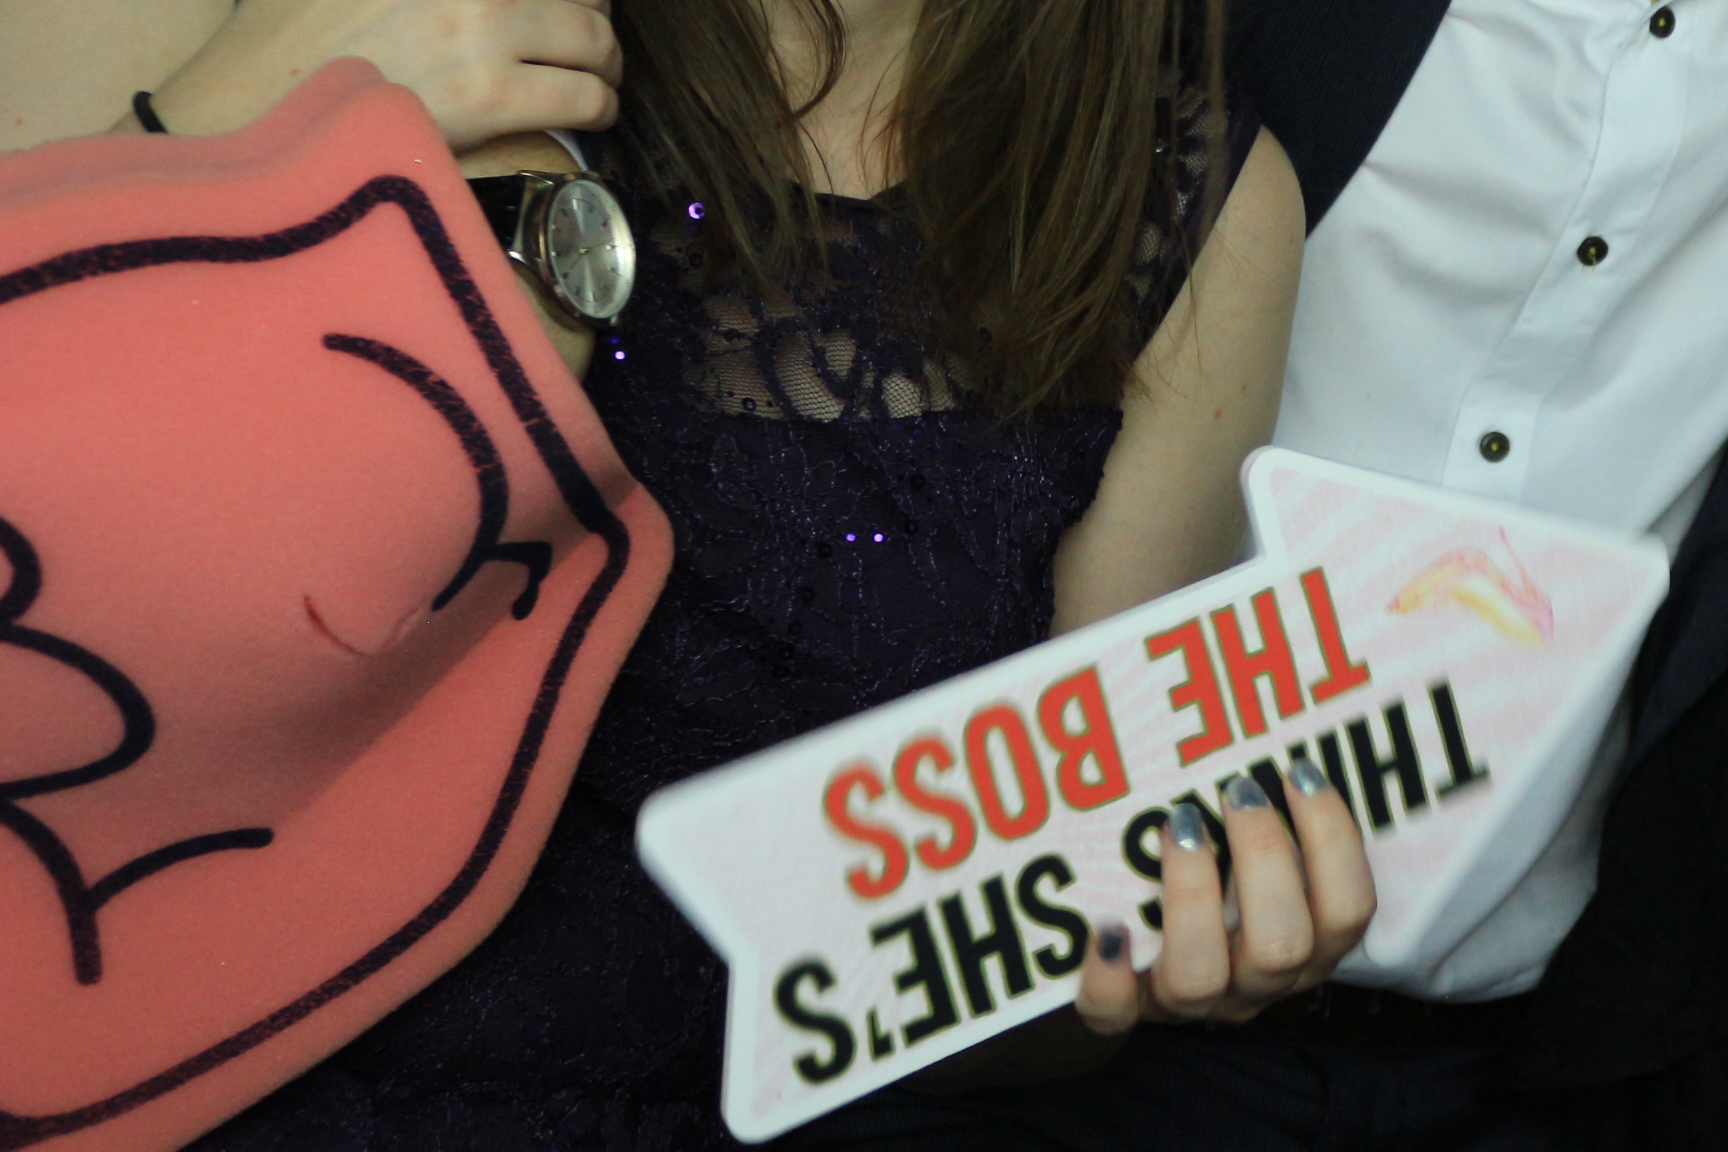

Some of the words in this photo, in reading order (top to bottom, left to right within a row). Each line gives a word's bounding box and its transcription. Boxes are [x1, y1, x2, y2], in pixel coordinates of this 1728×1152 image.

[822, 663, 1130, 901] BOSS
[1144, 566, 1371, 767] THE
[773, 852, 1092, 1085] SHE'S
